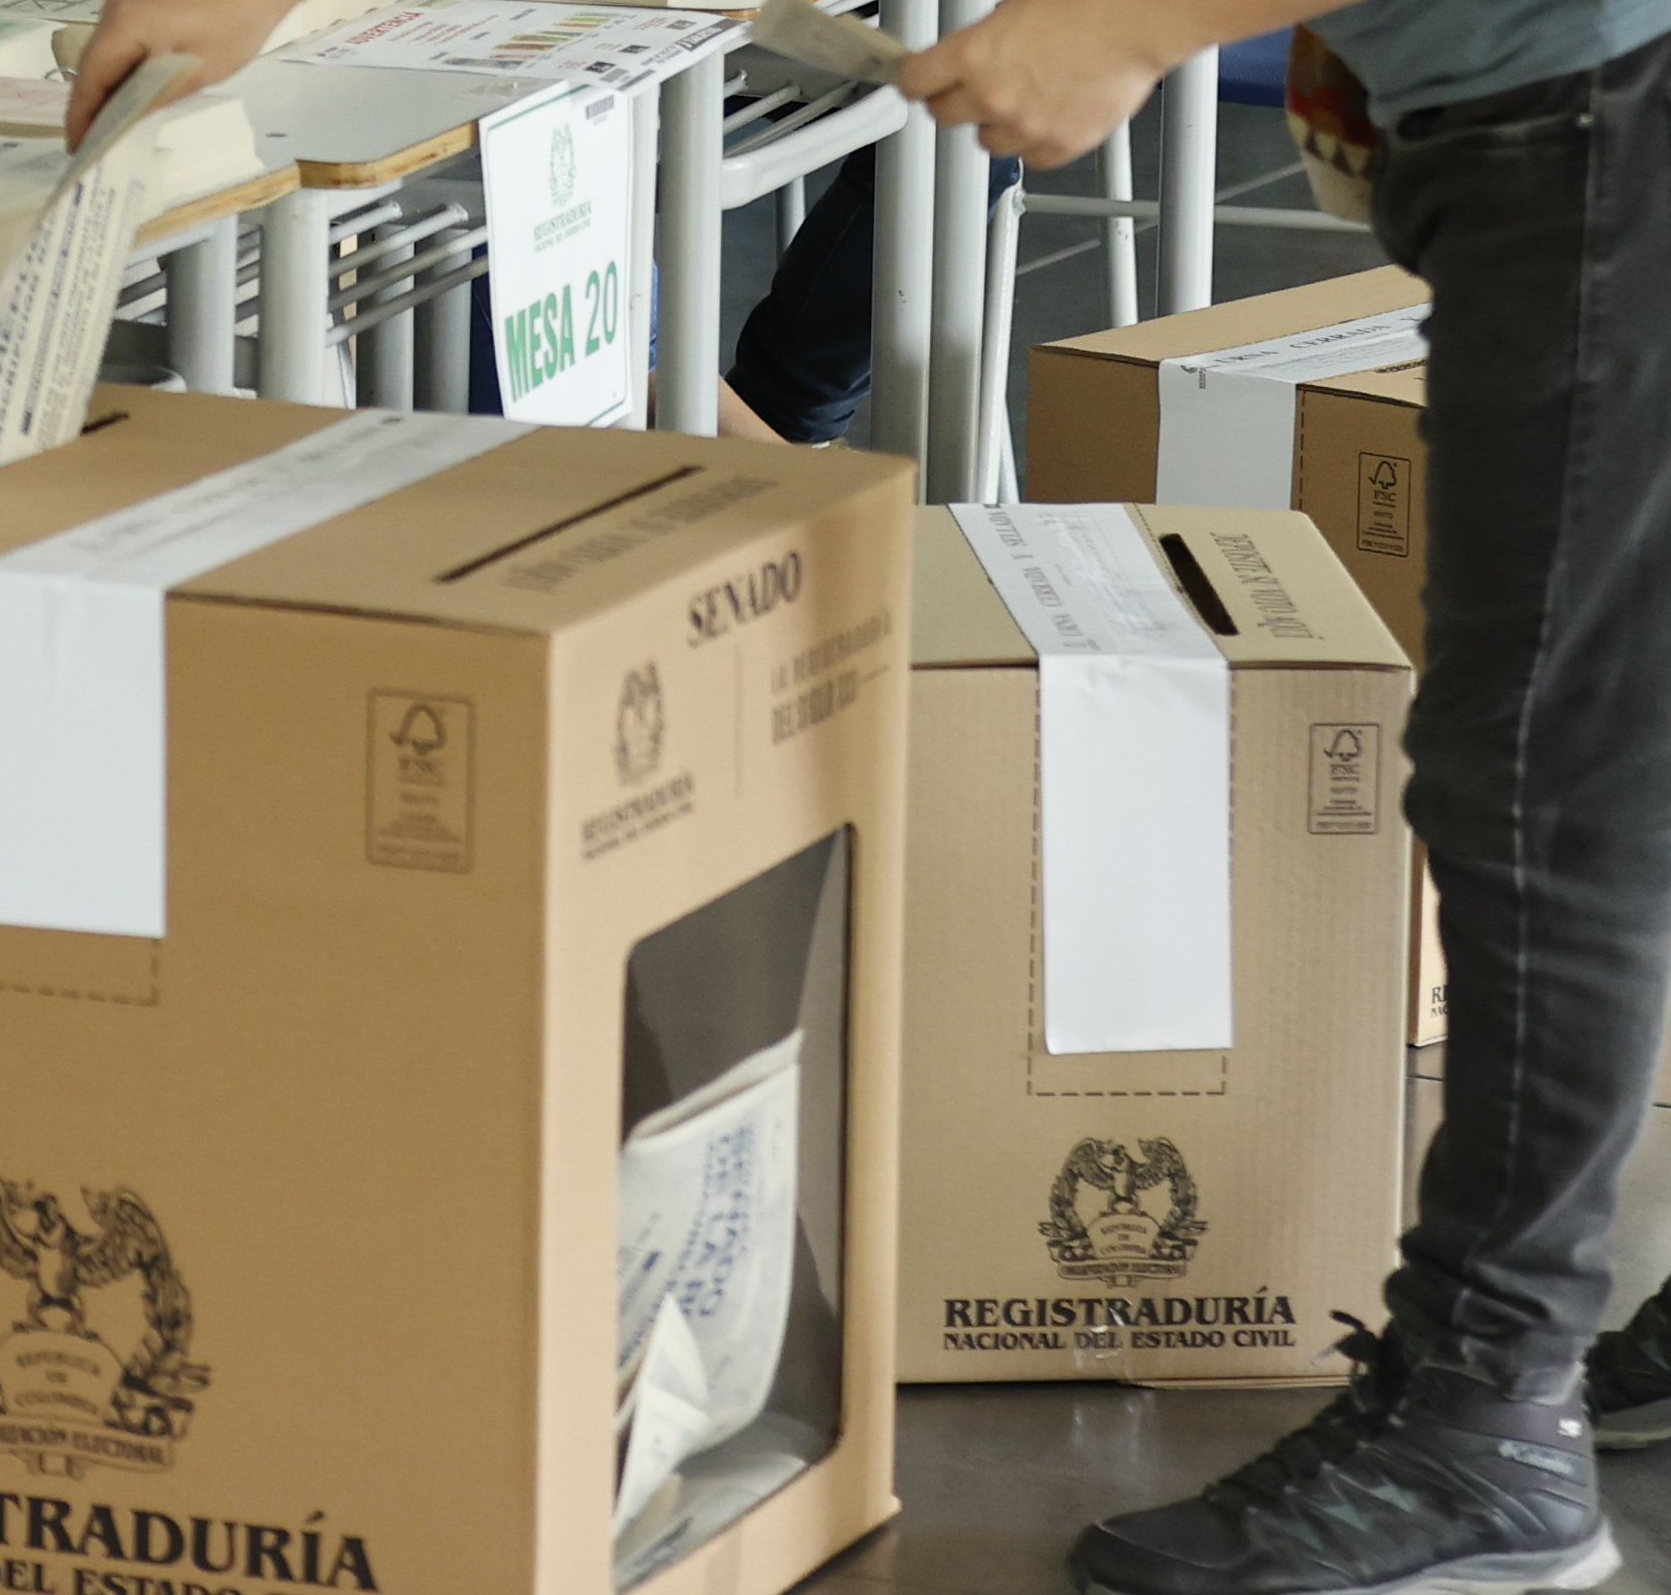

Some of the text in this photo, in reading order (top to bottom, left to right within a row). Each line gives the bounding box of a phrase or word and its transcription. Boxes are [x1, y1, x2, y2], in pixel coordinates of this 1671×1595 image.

[504, 260, 619, 403] MESA 20
[687, 550, 803, 648] SENADO
[943, 1286, 1296, 1328] REGISTRADURÍA
[943, 1330, 1296, 1350] NACIONAL DEL ESTADO CIVIL
